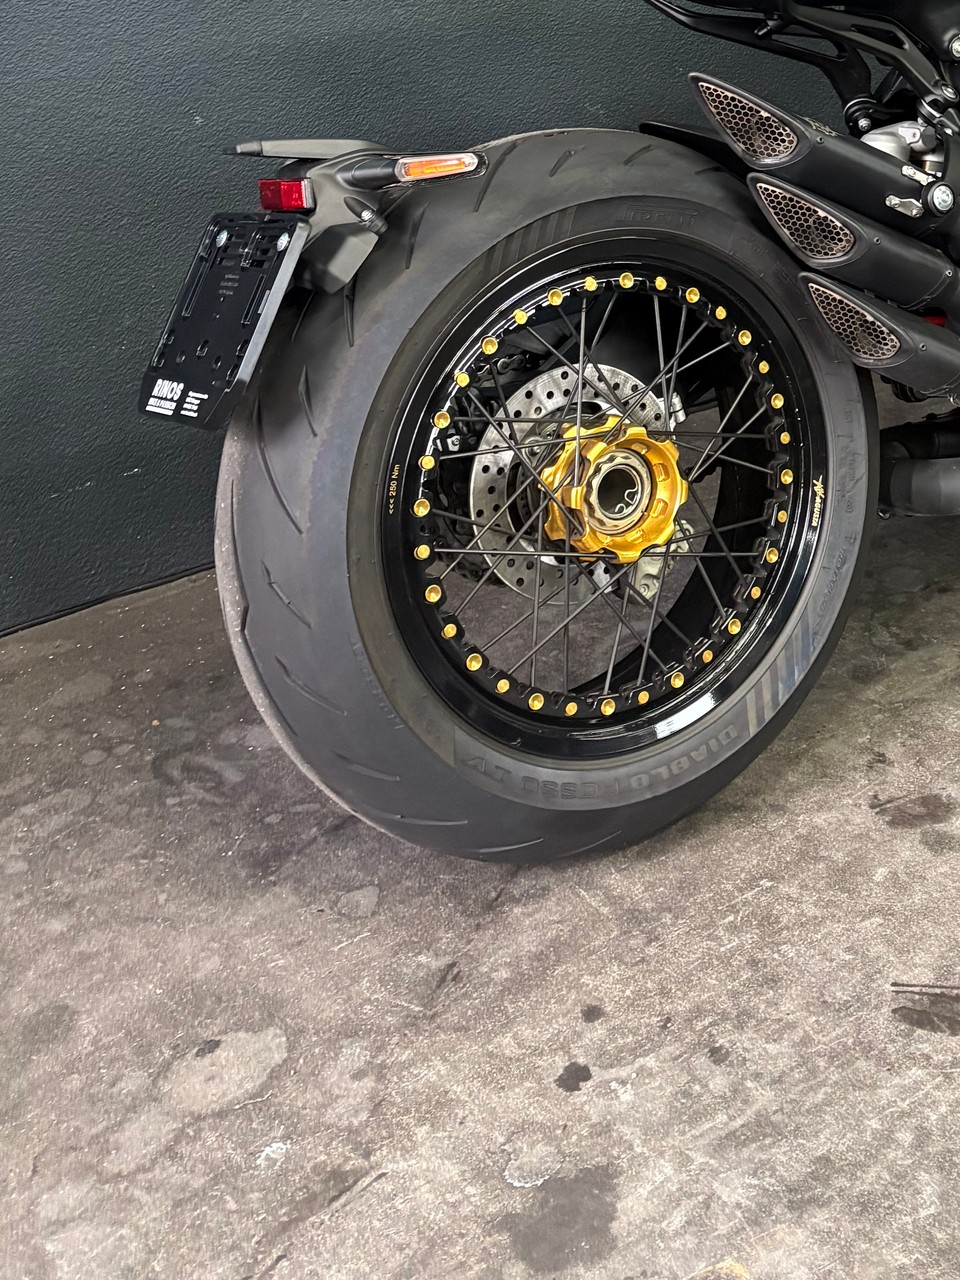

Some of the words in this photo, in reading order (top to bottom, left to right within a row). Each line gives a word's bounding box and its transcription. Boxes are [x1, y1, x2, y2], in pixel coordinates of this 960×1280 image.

[391, 464, 401, 479] Nm
[389, 480, 398, 496] 250
[630, 723, 738, 789] DIABLO
